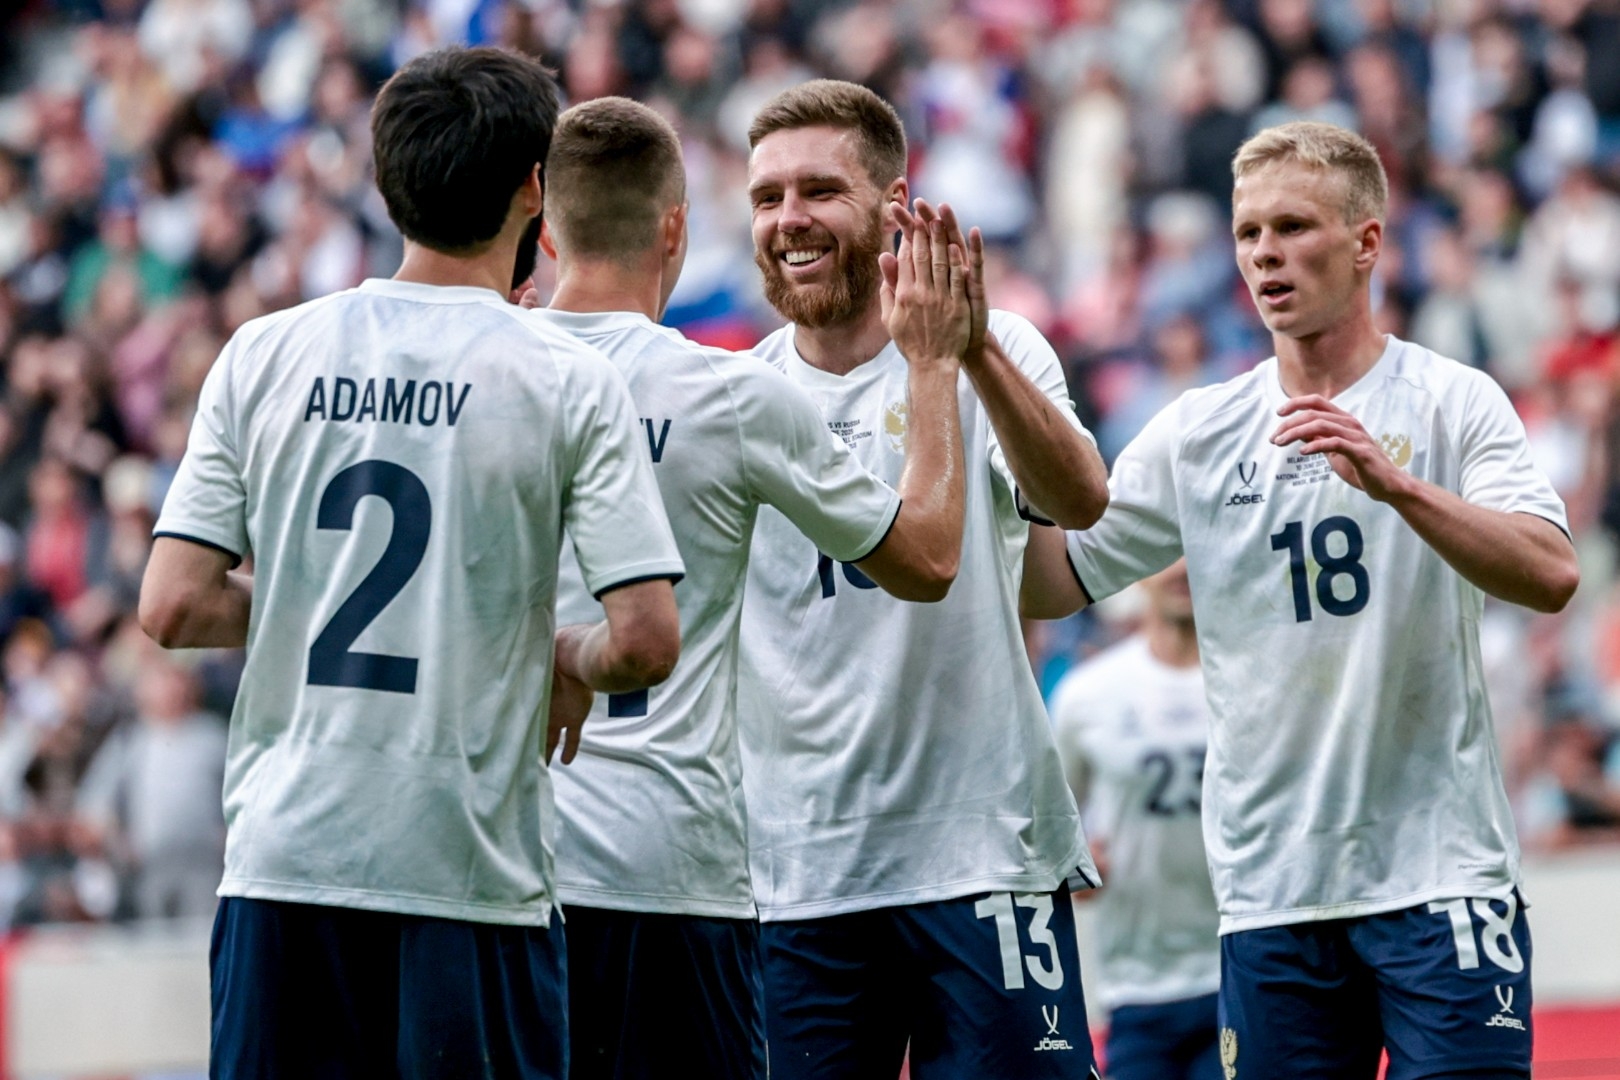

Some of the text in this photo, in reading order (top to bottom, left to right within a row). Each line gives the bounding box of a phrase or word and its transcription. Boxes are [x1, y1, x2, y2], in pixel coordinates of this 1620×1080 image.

[304, 376, 472, 428] ADAMOV
[843, 419, 860, 428] RUSSIA
[639, 417, 672, 463] V
[1225, 493, 1266, 506] JÖGEL
[1276, 472, 1300, 481] NATIONAL
[306, 459, 432, 695] 2
[1270, 515, 1370, 623] 18
[975, 891, 1065, 990] 13
[1427, 892, 1525, 974] 18
[1034, 1037, 1073, 1051] JÖGEL
[1485, 1013, 1526, 1031] JÖGEL
